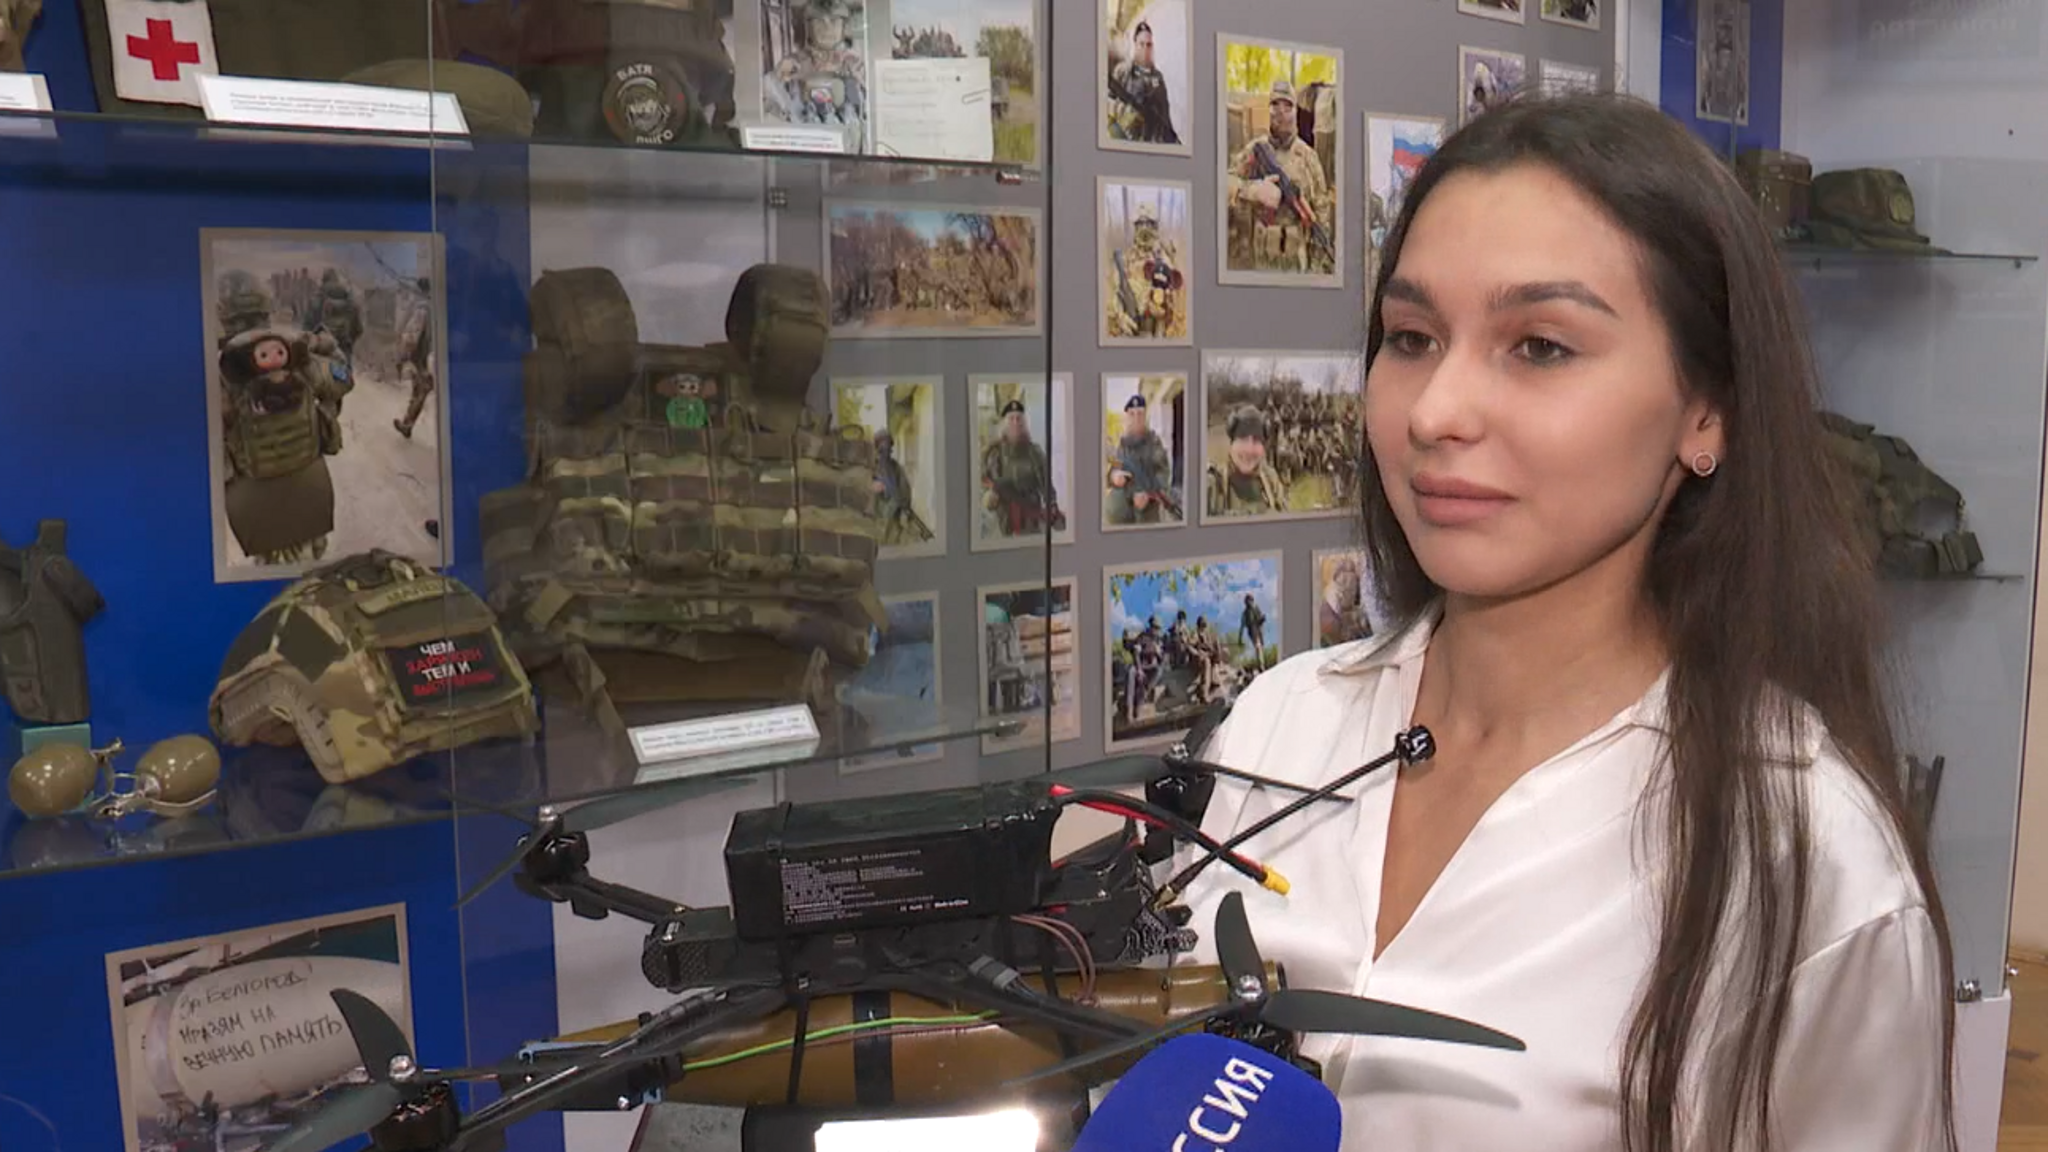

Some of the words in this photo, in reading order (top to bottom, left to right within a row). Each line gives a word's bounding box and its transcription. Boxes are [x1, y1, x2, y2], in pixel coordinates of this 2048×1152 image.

[419, 639, 456, 656] ЧЕМ
[421, 663, 457, 681] ТЕМ
[457, 660, 472, 674] И
[250, 1003, 278, 1024] НА
[183, 1041, 255, 1070] ВЕЧНУЮ
[260, 1014, 343, 1051] ПАМЯТЬ
